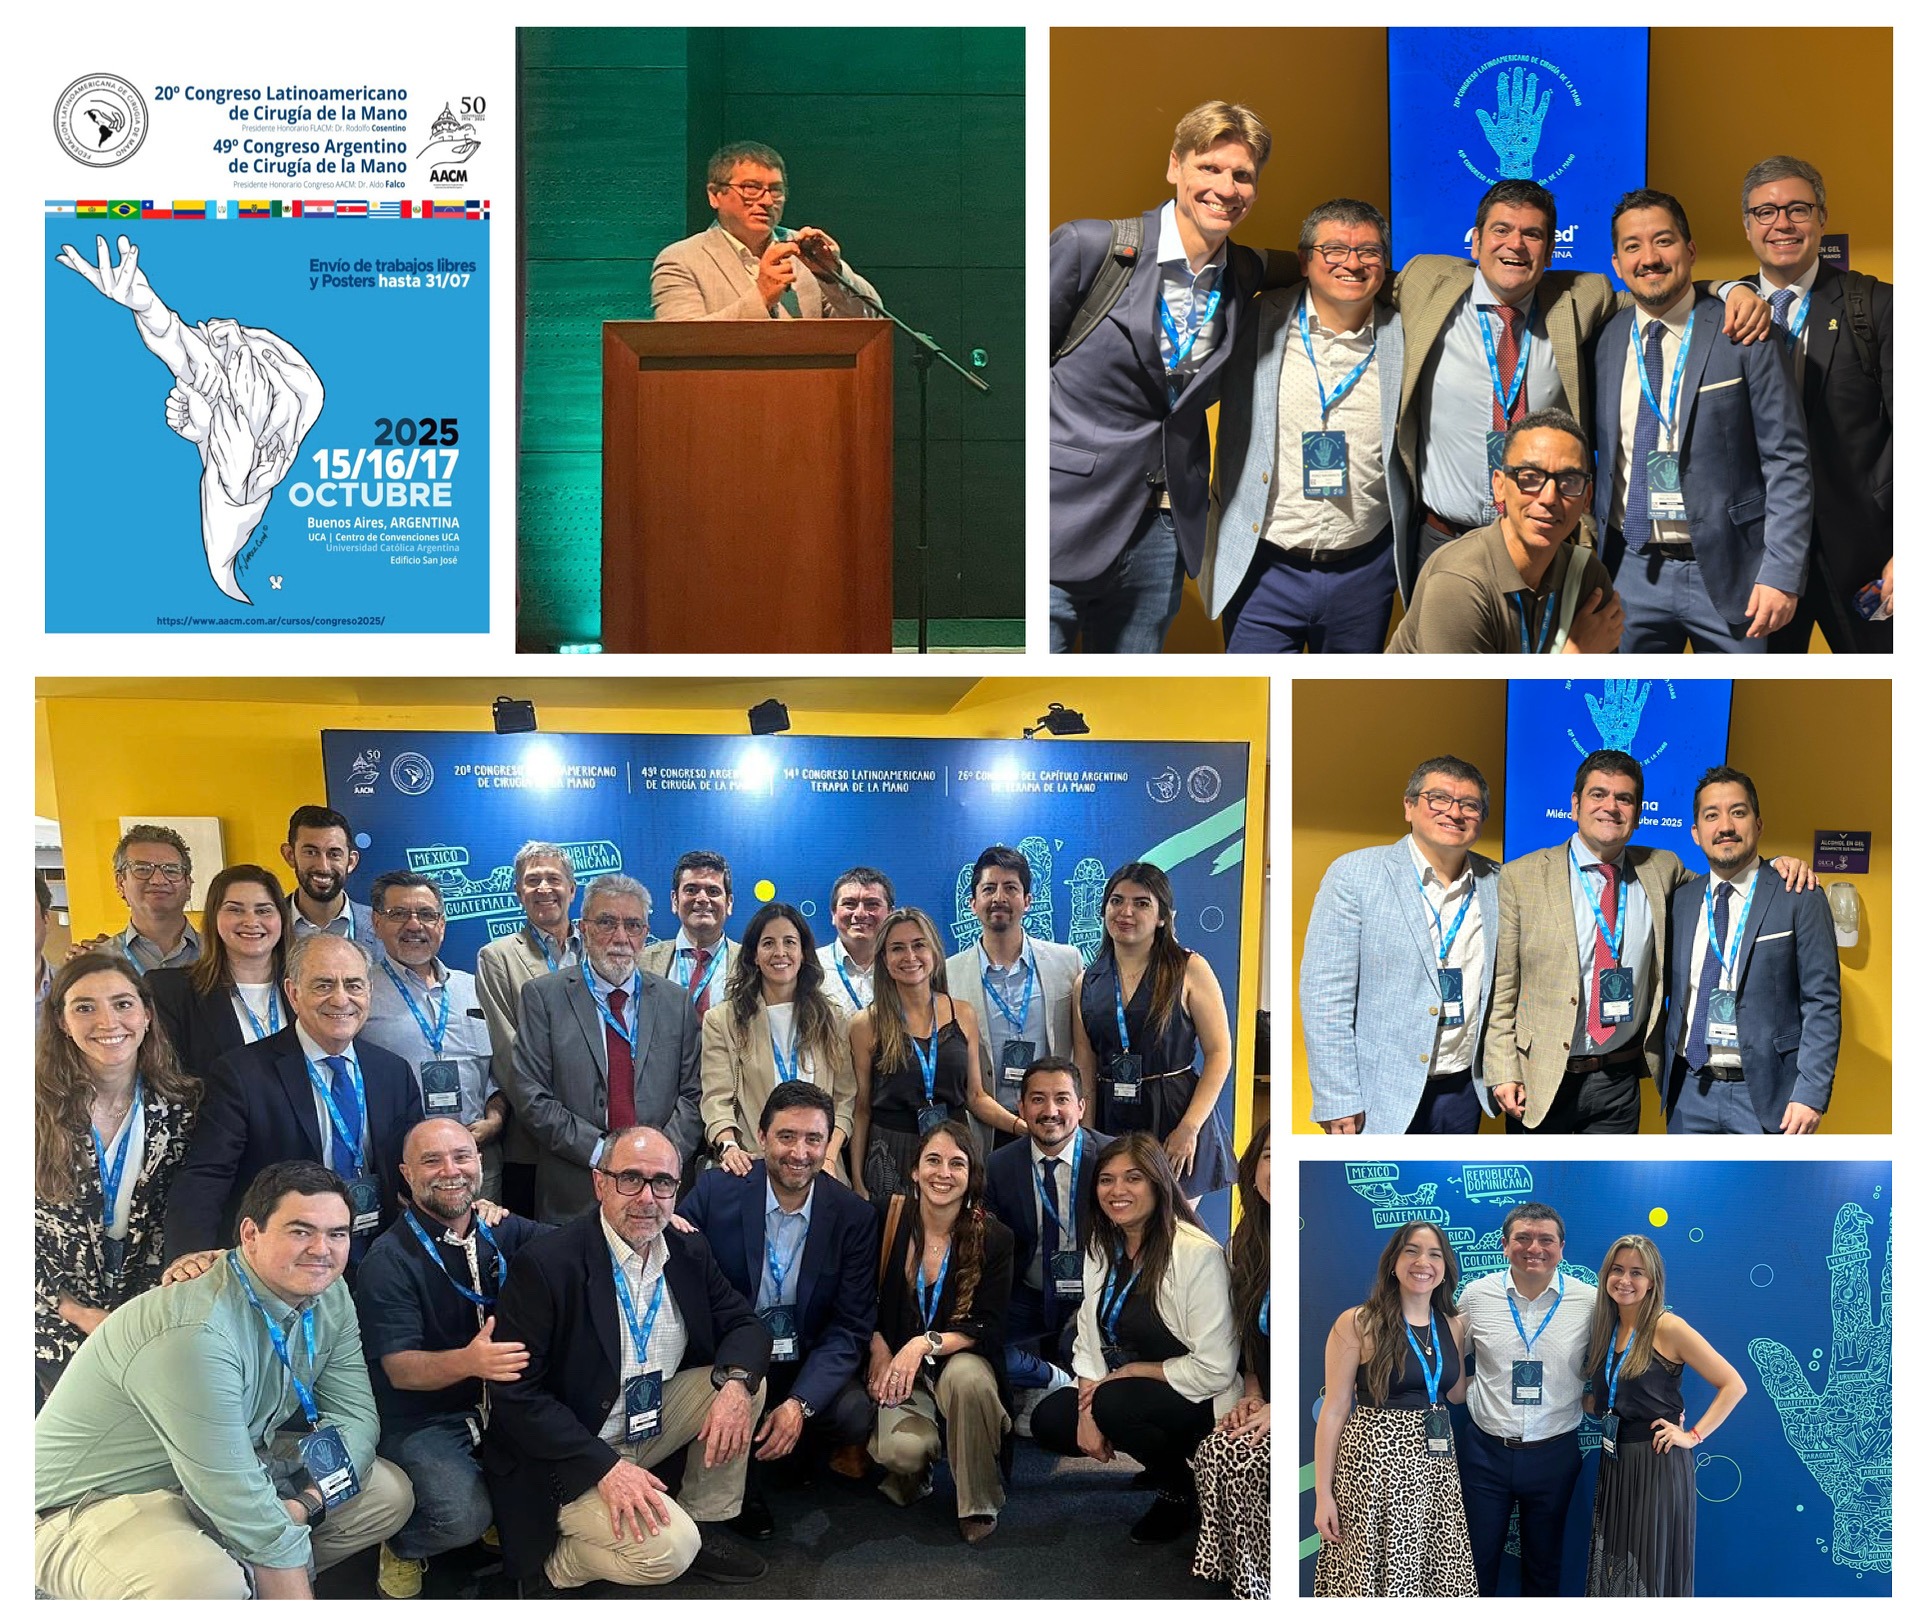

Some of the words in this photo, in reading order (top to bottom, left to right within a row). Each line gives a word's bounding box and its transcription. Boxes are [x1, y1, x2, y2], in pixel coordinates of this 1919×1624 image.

[117, 86, 128, 96] DE
[184, 86, 261, 105] Congreso
[267, 85, 407, 101] Latinoamericano
[1570, 89, 1582, 107] MANO
[61, 80, 116, 119] LATINOAMERICANA
[460, 96, 486, 115] 50
[229, 105, 249, 121] de
[254, 105, 312, 125] Cirugía
[316, 105, 337, 121] de
[342, 105, 356, 121] la
[361, 106, 407, 121] Mano
[132, 127, 140, 137] DE
[242, 124, 276, 132] Presidente
[276, 124, 309, 132] Honorario
[310, 124, 334, 132] FLACM:
[334, 124, 344, 132] Dr.
[345, 124, 370, 132] Rodolfo
[371, 124, 407, 132] Cosentino
[115, 138, 135, 157] MANO
[243, 139, 320, 158] Congreso
[324, 138, 408, 158] Argentino
[228, 158, 249, 173] de
[253, 158, 312, 178] Cirugía
[316, 158, 336, 173] de
[341, 158, 355, 173] la
[361, 159, 407, 173] Mano
[430, 169, 468, 183] AACM
[233, 181, 268, 189] Presidente
[269, 181, 302, 189] Honorario
[303, 181, 334, 190] Congreso
[335, 181, 356, 189] AACM:
[358, 181, 368, 189] Dr.
[369, 181, 384, 189] Aldo
[385, 180, 406, 189] Falco
[310, 258, 350, 273] Envío
[353, 258, 372, 273] de
[375, 258, 434, 275] trabajos
[437, 257, 476, 273] libres
[309, 277, 319, 290] y
[322, 274, 376, 288] Posters
[378, 274, 421, 288] hasta
[425, 273, 471, 289] 31/07
[374, 418, 459, 446] 2025
[312, 448, 460, 480] 15/16/17
[288, 482, 452, 508] OCTUBRE
[307, 517, 351, 529] Buenos
[354, 517, 387, 531] Aires,
[390, 517, 460, 529] ARGENTINA
[308, 533, 327, 542] UCA
[335, 533, 366, 542] Centro
[367, 533, 378, 542] de
[379, 533, 440, 542] Convenciones
[441, 533, 460, 542] UCA
[326, 543, 378, 552] Universidad
[380, 543, 415, 552] Católica
[417, 543, 460, 555] Argentina
[390, 556, 421, 565] Edificio
[422, 556, 438, 565] San
[439, 555, 458, 566] José
[156, 615, 386, 627] https://www.aacm.com.ar/cursos/congreso2025/
[660, 769, 707, 779] CONGRESO
[802, 768, 849, 780] CONGRESO
[852, 769, 936, 781] LATINOAMERICANO
[1040, 769, 1079, 781] CAPÍTULO
[1081, 771, 1129, 782] ARGENTINO
[477, 778, 490, 788] DE
[567, 778, 596, 789] MANO
[646, 779, 658, 790] DE
[661, 778, 696, 790] CIRUGÍA
[700, 780, 711, 790] DE
[714, 780, 727, 791] LA
[811, 781, 849, 793] TERAPIA
[852, 782, 864, 793] DE
[867, 782, 880, 793] LA
[882, 782, 909, 793] MANO
[1044, 783, 1054, 793] DE
[1057, 783, 1068, 793] LA
[1070, 782, 1096, 794] MANO
[1546, 808, 1572, 819] Miérc
[1661, 817, 1682, 828] 2025
[414, 849, 458, 867] MÉXICO
[445, 896, 516, 916] GUATEMALA
[1352, 1165, 1390, 1179] MÉXICO
[1467, 1166, 1521, 1182] REPÚBLICA
[1468, 1177, 1530, 1191] DOMINICANA
[1375, 1210, 1437, 1224] GUATEMALA
[1449, 1230, 1471, 1241] RICA
[1831, 1251, 1867, 1265] VENEZUELA
[1840, 1373, 1868, 1381] URUGUAY
[1779, 1399, 1818, 1408] GUATEMALA
